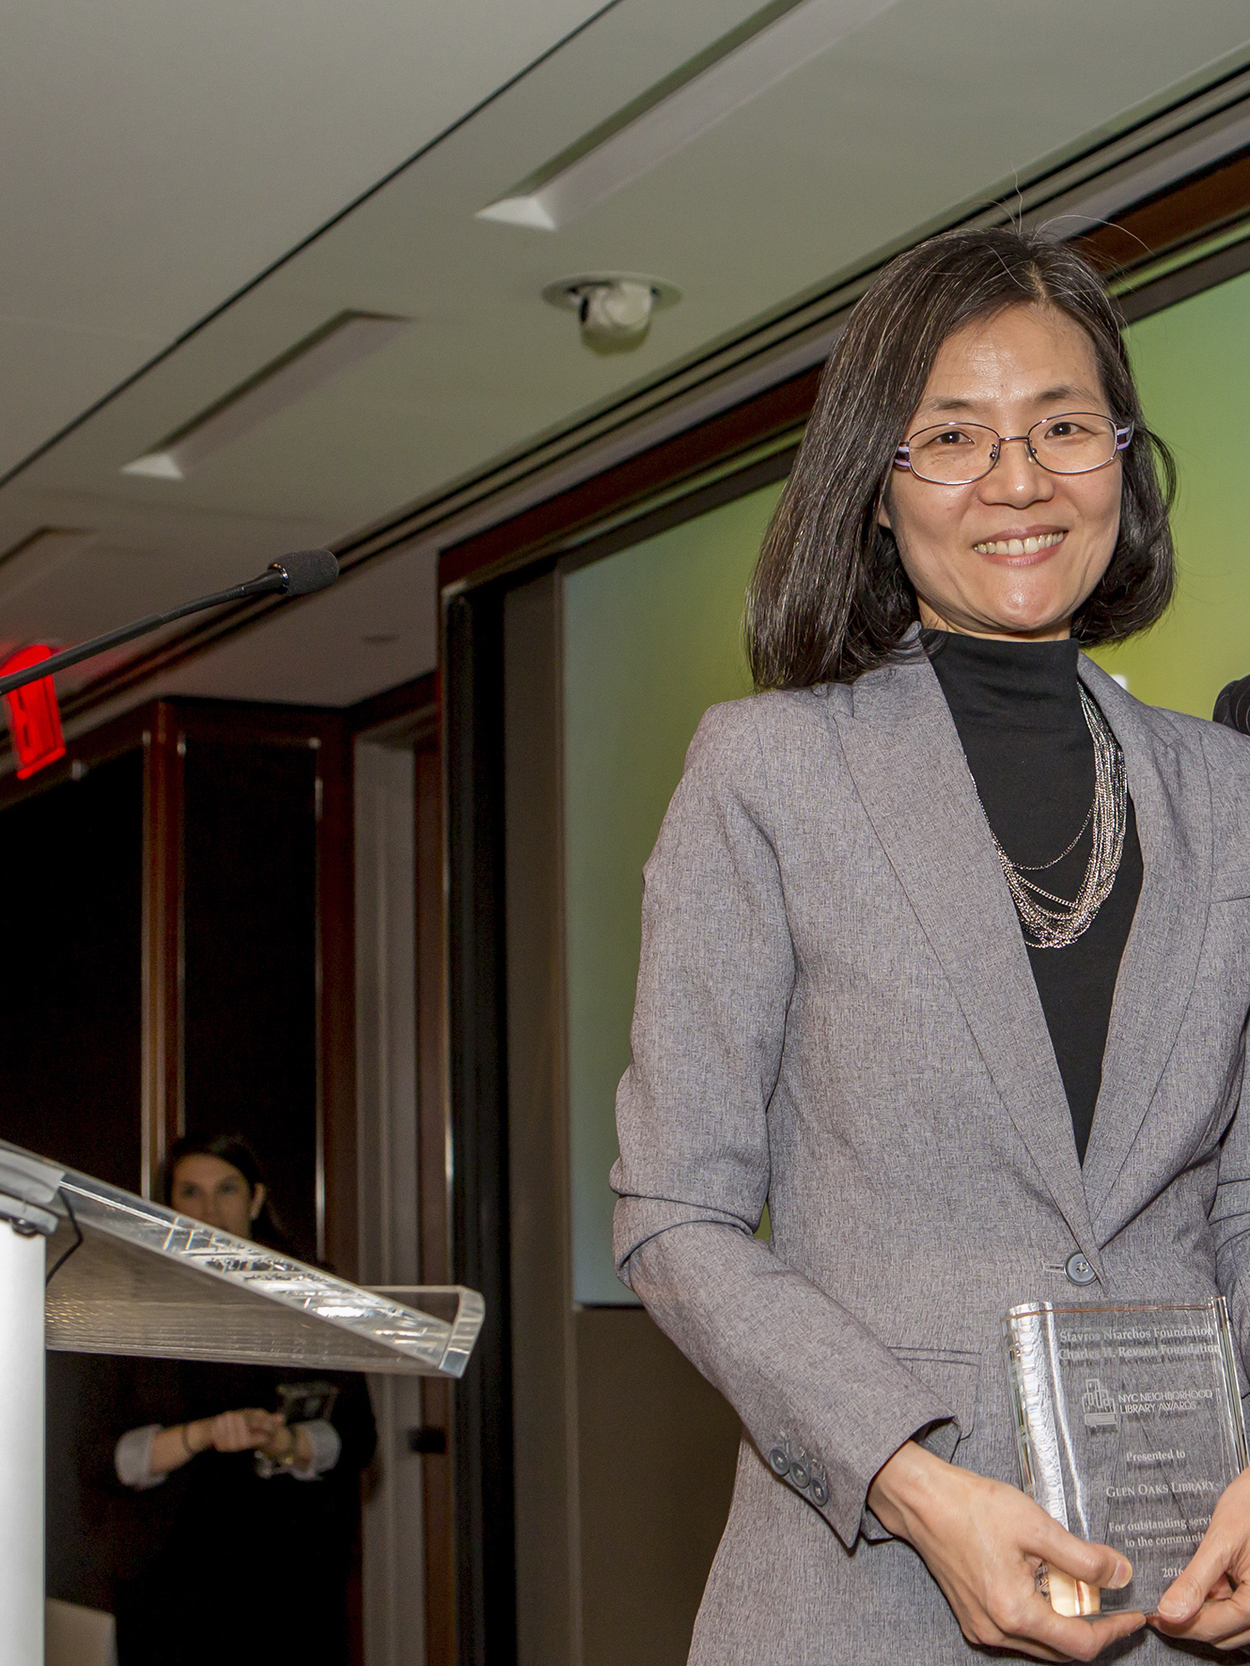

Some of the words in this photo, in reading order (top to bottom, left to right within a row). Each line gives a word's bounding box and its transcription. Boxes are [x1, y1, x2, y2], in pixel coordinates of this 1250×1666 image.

[1060, 1330, 1100, 1343] Stavros
[1103, 1328, 1151, 1341] Niarchos
[1154, 1326, 1215, 1338] Foundation
[1058, 1348, 1101, 1360] Charles
[1118, 1346, 1158, 1358] Revson
[1160, 1344, 1221, 1356] Foundation
[1118, 1394, 1139, 1404] NYC
[1140, 1389, 1213, 1402] NEIGHBORHOOD
[1119, 1403, 1156, 1414] LIBRARY
[1158, 1400, 1197, 1412] AWARDS
[1126, 1449, 1174, 1462] Presented
[1176, 1450, 1186, 1460] to
[1106, 1486, 1135, 1498] GLEN
[1138, 1484, 1169, 1496] OAKS
[1171, 1481, 1216, 1493] LIBRARY
[1109, 1521, 1125, 1532] For
[1127, 1518, 1187, 1532] outstanding
[1125, 1538, 1135, 1548] to
[1138, 1536, 1154, 1547] the
[1162, 1567, 1184, 1578] 2016
